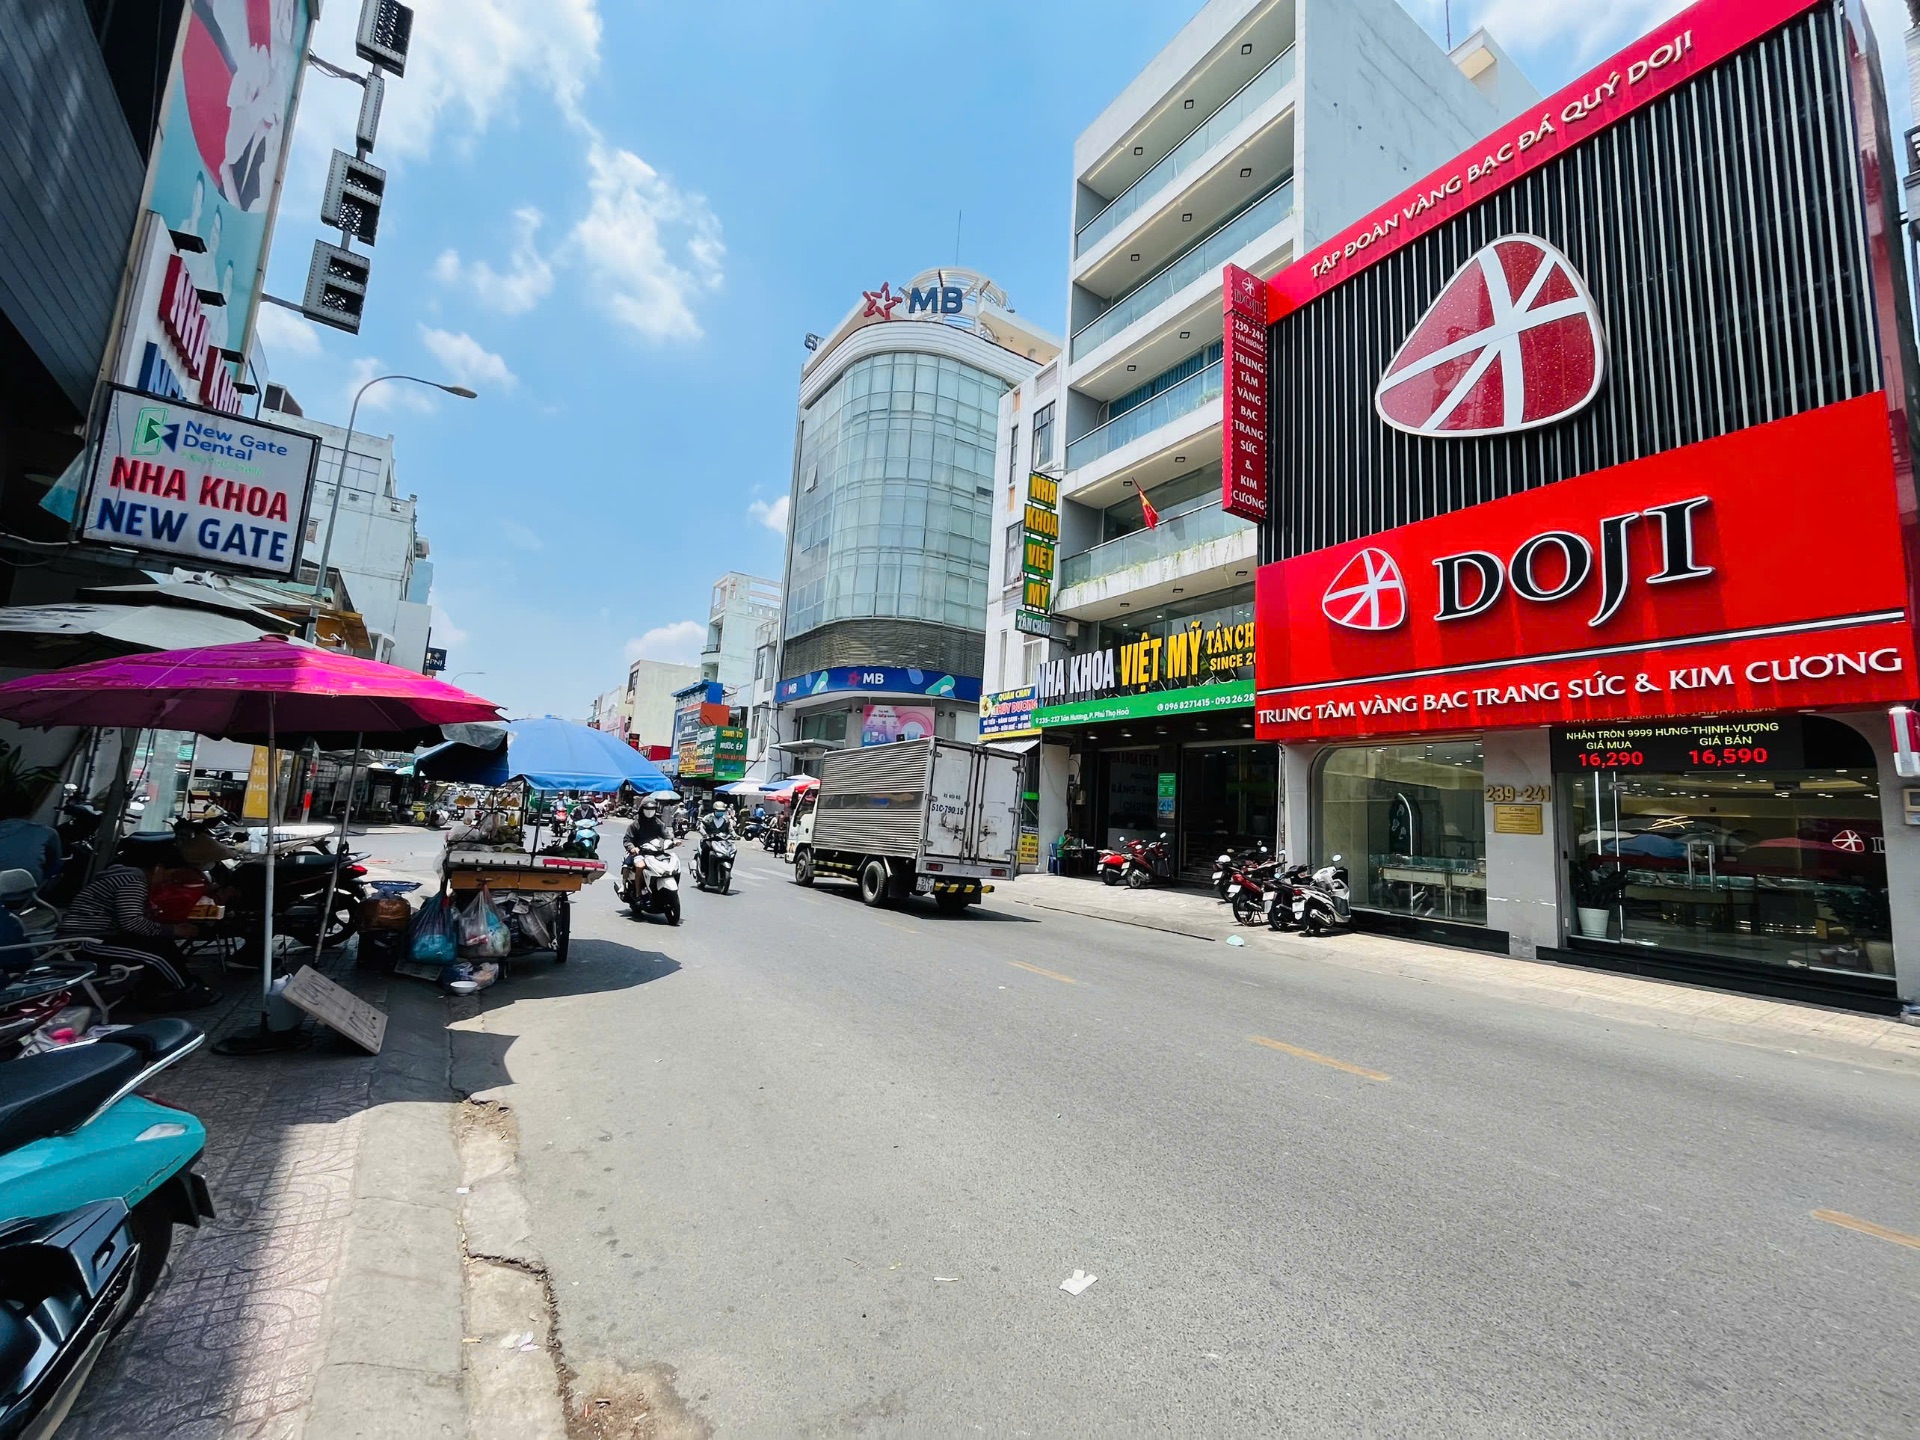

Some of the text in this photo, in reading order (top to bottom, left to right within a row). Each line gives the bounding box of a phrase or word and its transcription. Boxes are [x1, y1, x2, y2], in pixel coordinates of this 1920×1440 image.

[1311, 30, 1692, 278] TẬP ĐOÀN VÀNG BẠC ĐÁ QUÝ DOJI
[908, 286, 963, 314] MB
[1234, 288, 1263, 316] DOJI
[1235, 320, 1264, 342] 239-241
[1235, 332, 1245, 342] TÂN
[1234, 351, 1264, 374] TRUNG
[1240, 370, 1259, 388] TÂM
[1237, 386, 1262, 406] VÀNG
[1240, 406, 1258, 421] BẠC
[186, 420, 288, 456] New Gate
[1234, 420, 1264, 440] TRANG
[183, 434, 252, 460] Dental
[1240, 440, 1258, 455] SỨC
[1245, 460, 1253, 470] &
[110, 456, 186, 501] NHA
[198, 476, 288, 522] KHOA
[1031, 476, 1056, 505] NHA
[1240, 474, 1258, 490] KIM
[1233, 490, 1264, 510] CƯƠNG
[97, 498, 288, 562] NEW GATE
[1026, 506, 1058, 536] KHOA
[1028, 542, 1054, 573] VIỆT
[1431, 495, 1716, 628] DOJI
[1028, 581, 1049, 608] MỸ
[1018, 614, 1050, 636] TÂN CHÂU
[1206, 622, 1234, 654] TÂN
[1036, 620, 1202, 699] NHA KHOA VIỆT MỸ
[1210, 652, 1256, 670] SINCE 2
[862, 672, 884, 684] MB
[1258, 647, 1902, 724] TRUNG TÂM VÀNG BẠC TRANG SỨC & KIM CƯƠNG
[788, 683, 798, 694] MB
[1164, 702, 1178, 710] 096
[1180, 698, 1210, 709] 8271415
[1215, 696, 1230, 706] 093
[1232, 695, 1242, 704] 26
[1596, 728, 1625, 738] TRÒN
[1628, 728, 1652, 738] 9999
[1700, 736, 1752, 746] GIÁ BÁN
[1586, 740, 1632, 750] GIÁ MUA
[1578, 752, 1644, 768] 16,290
[1689, 748, 1768, 766] 16,590
[1485, 785, 1551, 802] 239-241
